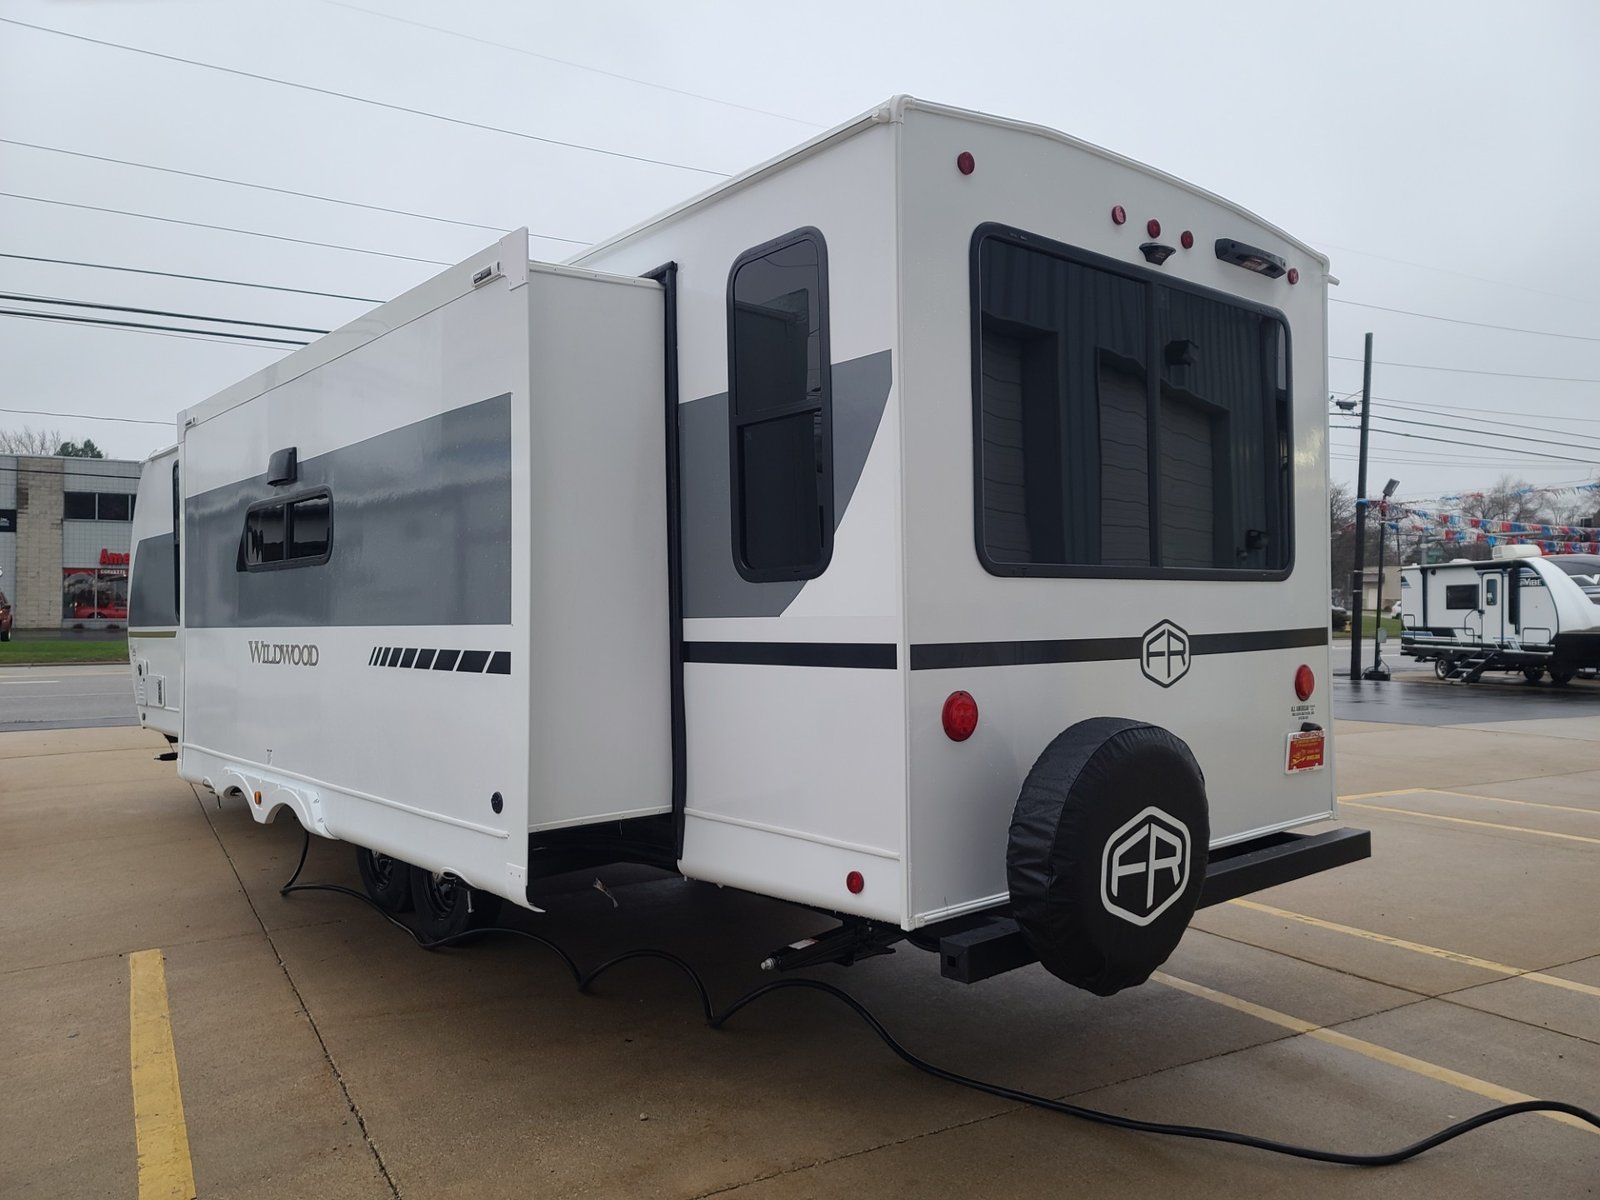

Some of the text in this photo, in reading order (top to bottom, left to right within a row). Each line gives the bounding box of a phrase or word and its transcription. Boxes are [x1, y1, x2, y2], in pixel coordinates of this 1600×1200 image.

[248, 640, 319, 667] WILDWOOD
[1145, 627, 1188, 680] FR
[1107, 818, 1186, 913] FR
